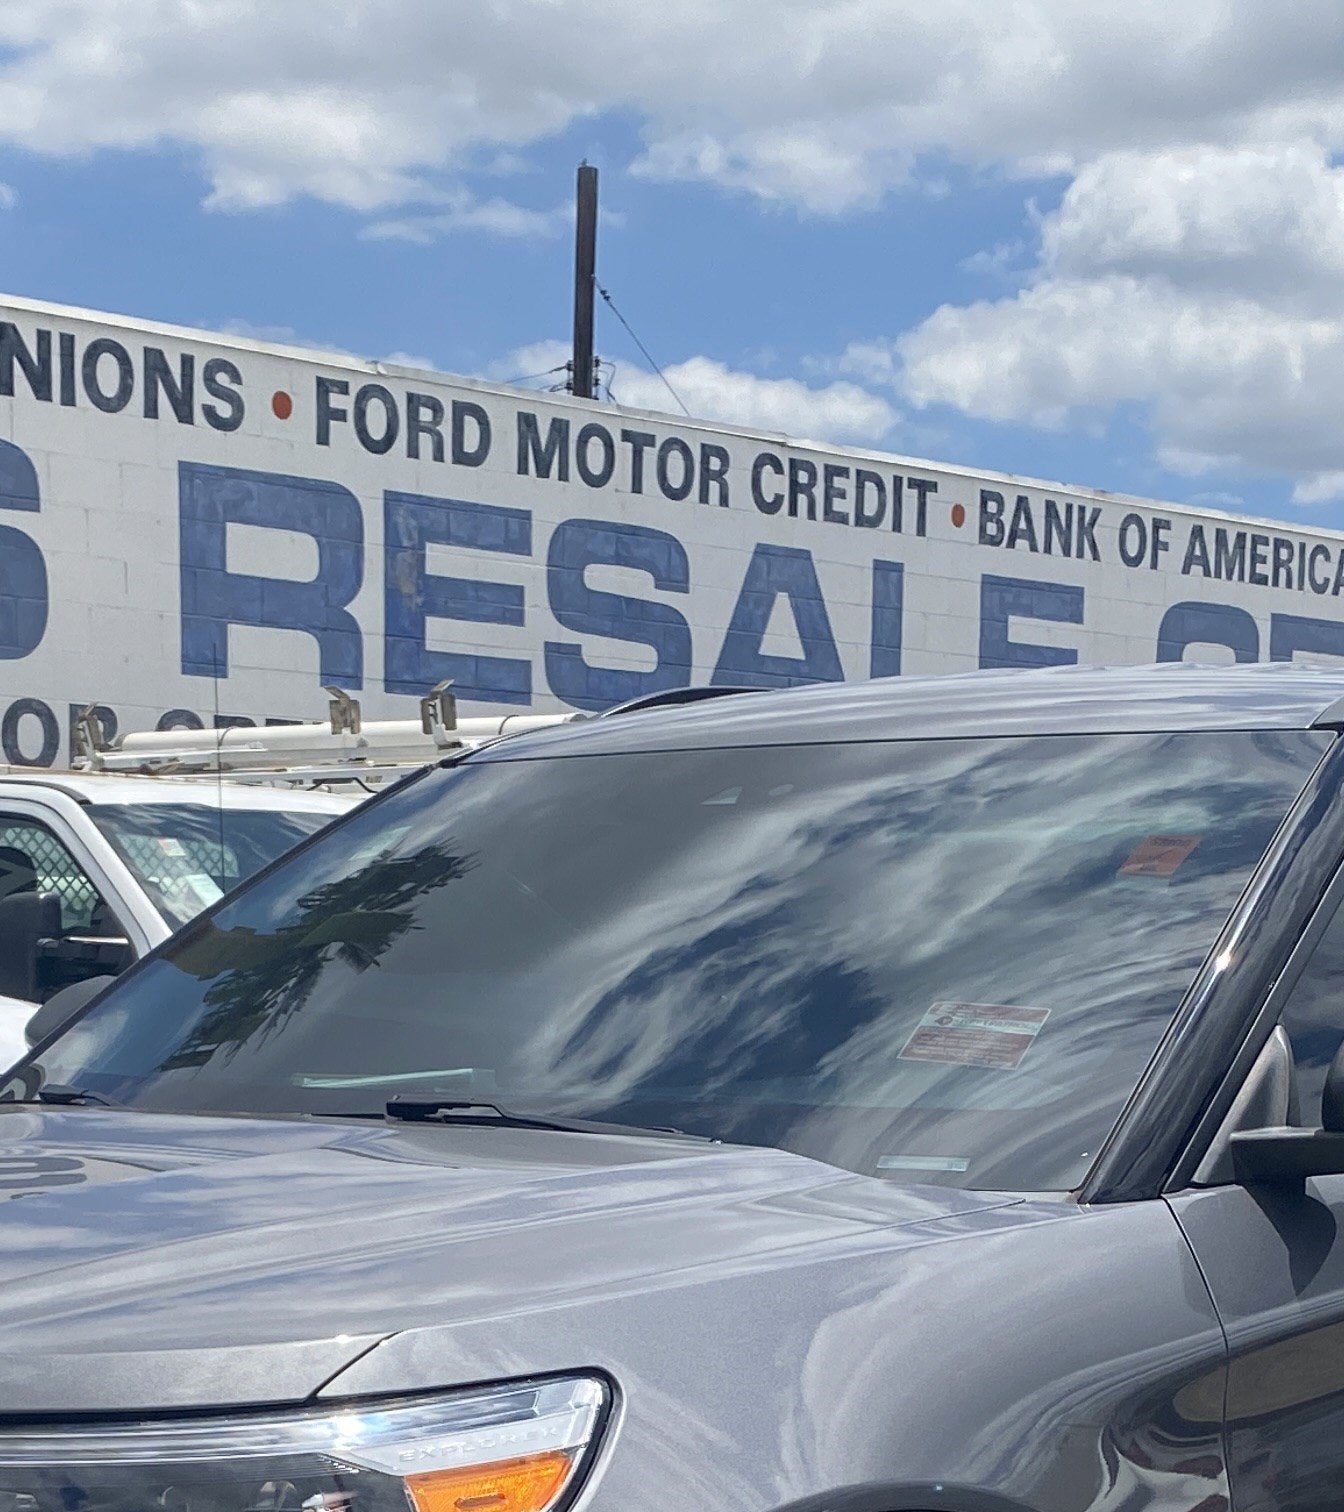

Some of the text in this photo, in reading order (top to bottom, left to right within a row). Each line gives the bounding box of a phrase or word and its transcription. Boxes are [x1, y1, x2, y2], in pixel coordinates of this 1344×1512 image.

[315, 375, 491, 468] FORD
[516, 410, 731, 507] MOTOR
[751, 452, 939, 538] CREDIT
[978, 488, 1102, 563] BANK
[1118, 512, 1172, 571] OF
